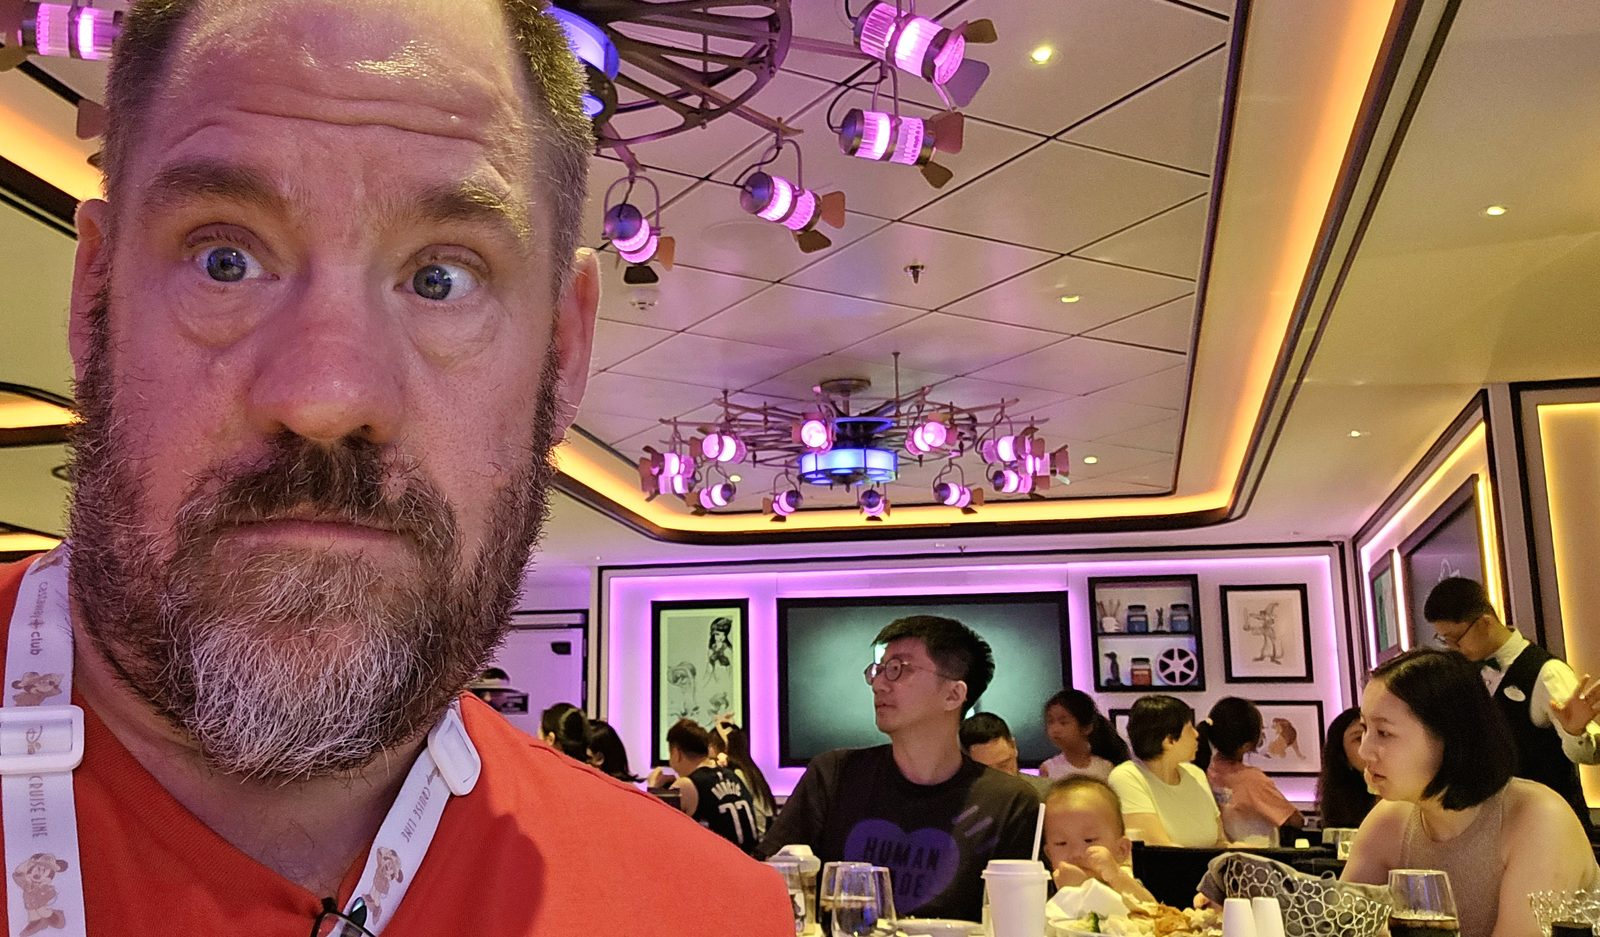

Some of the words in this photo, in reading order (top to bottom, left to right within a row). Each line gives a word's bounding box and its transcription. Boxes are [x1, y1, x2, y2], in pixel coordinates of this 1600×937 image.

[30, 631, 44, 656] club
[28, 775, 46, 813] CRUISE
[412, 786, 430, 820] CRUISE
[30, 816, 48, 838] LINE
[401, 818, 417, 843] LINE
[718, 800, 759, 844] 77
[863, 837, 939, 871] HUMAN
[898, 872, 926, 898] DE
